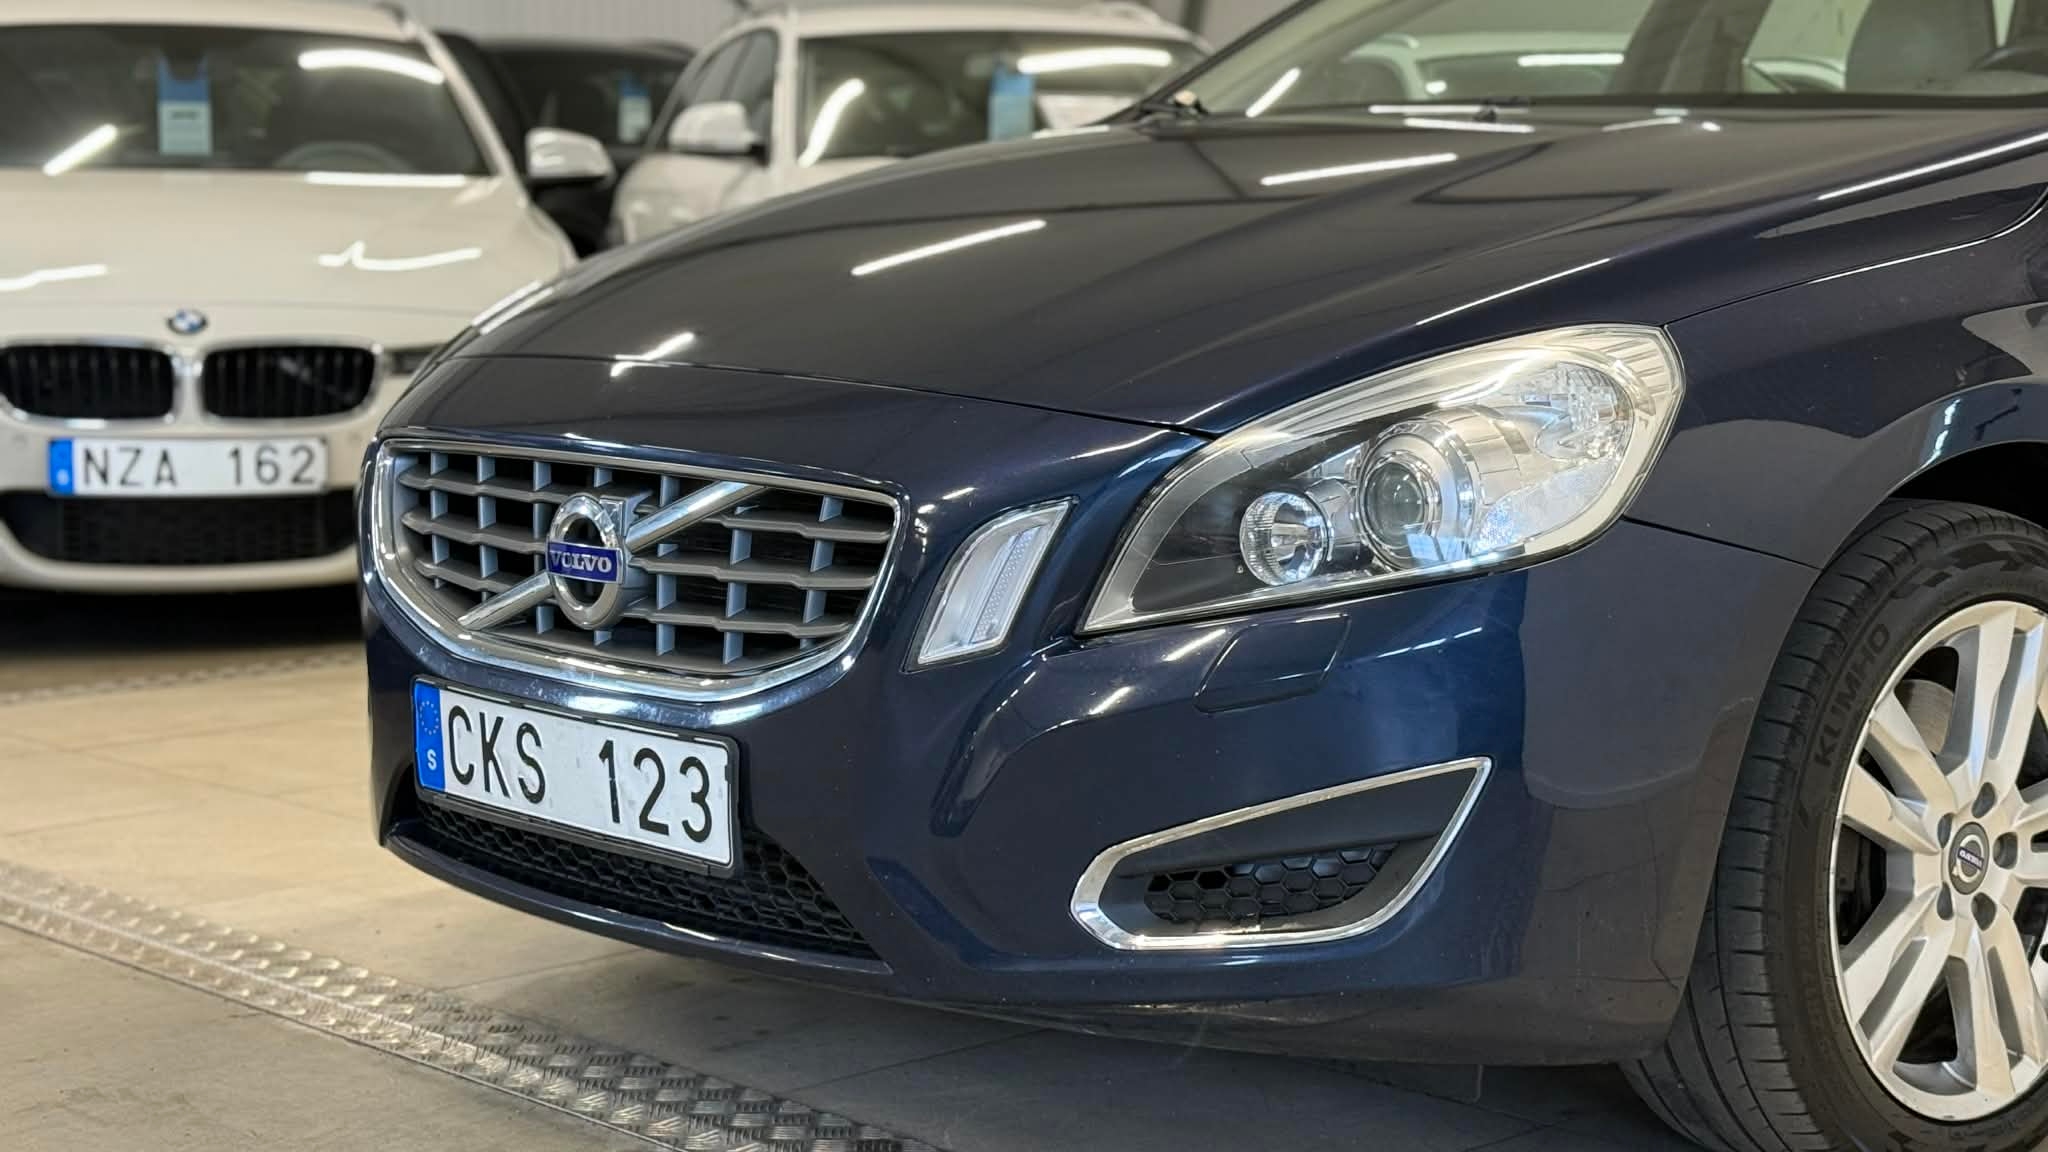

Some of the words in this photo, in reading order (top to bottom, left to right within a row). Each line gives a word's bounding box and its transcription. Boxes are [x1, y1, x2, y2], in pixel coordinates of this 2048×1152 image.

[83, 448, 177, 486] NZA
[229, 445, 315, 485] 162
[549, 550, 612, 573] VOLVO
[1813, 623, 1890, 767] KUMHO
[426, 748, 438, 771] S
[448, 704, 546, 804] CKS
[598, 739, 712, 844] 123
